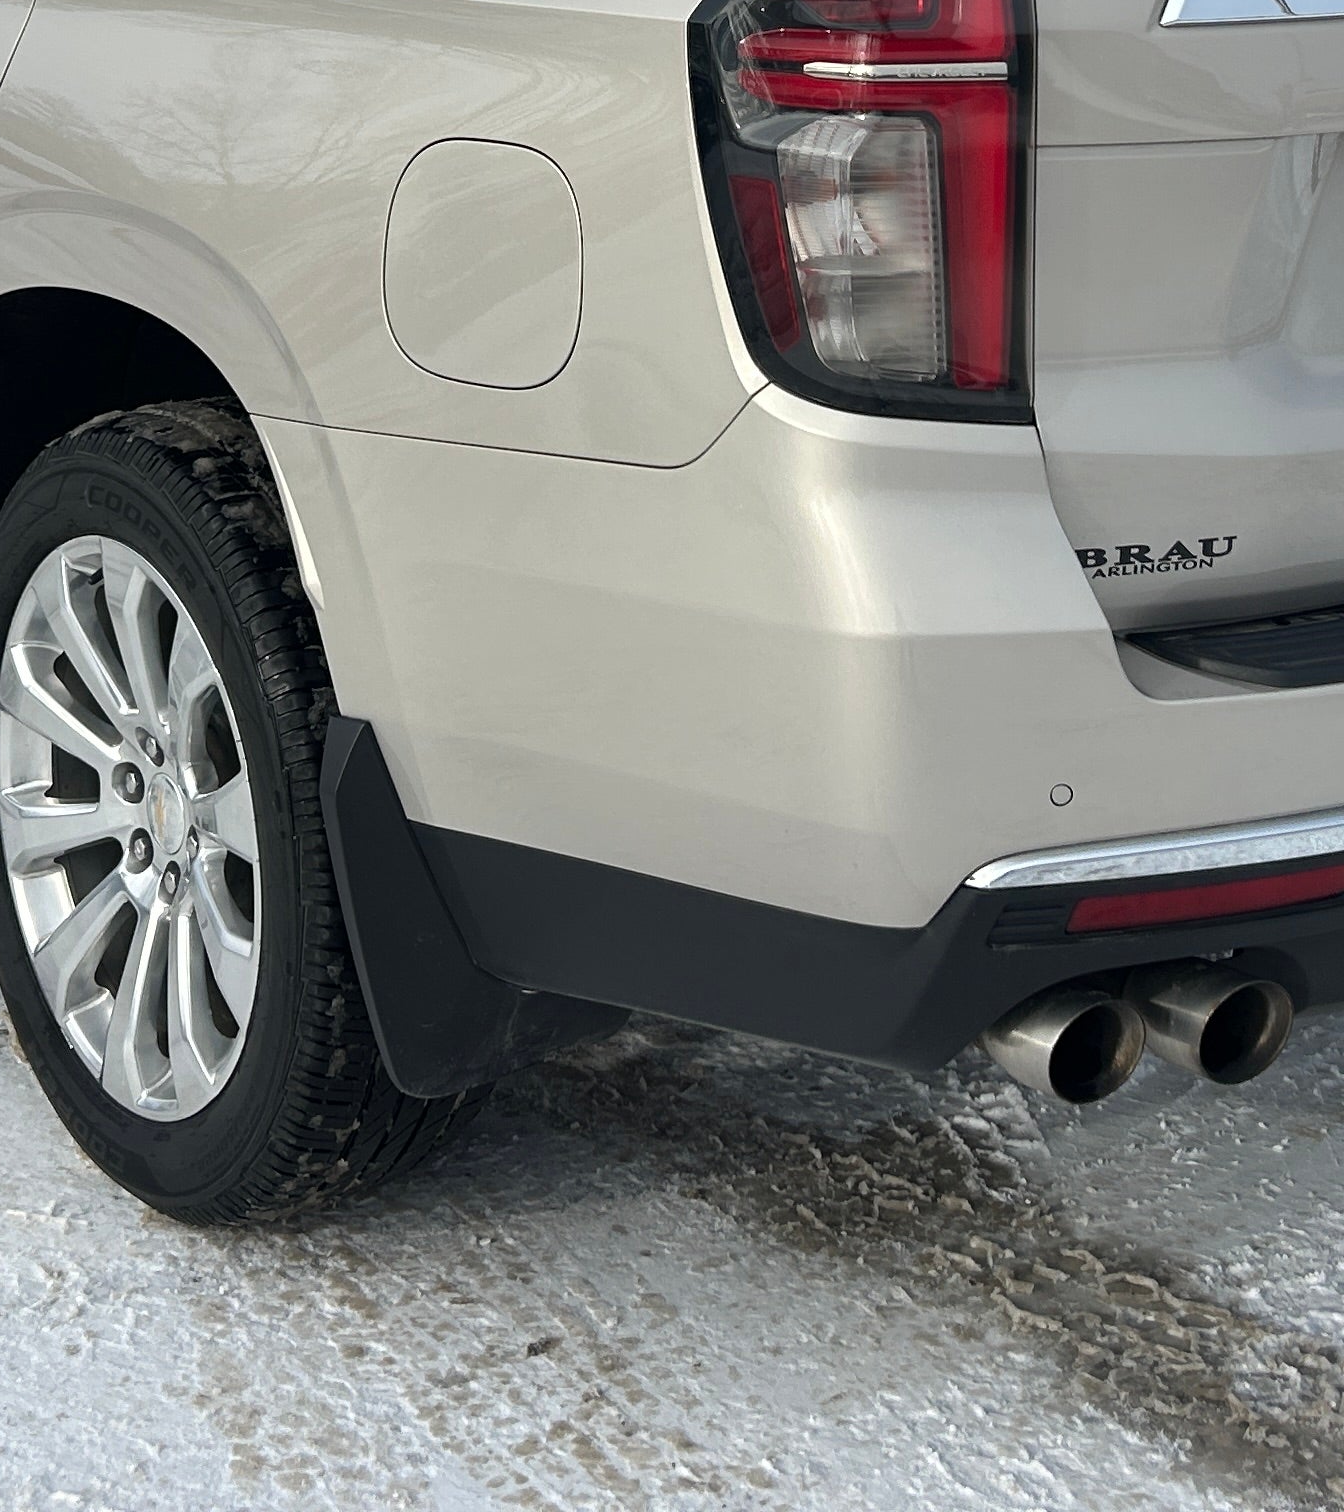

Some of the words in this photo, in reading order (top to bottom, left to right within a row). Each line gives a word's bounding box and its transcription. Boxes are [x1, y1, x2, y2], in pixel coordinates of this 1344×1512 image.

[87, 485, 196, 592] COOPER
[1074, 535, 1238, 568] BRAU
[1092, 557, 1214, 579] ARLINGTON
